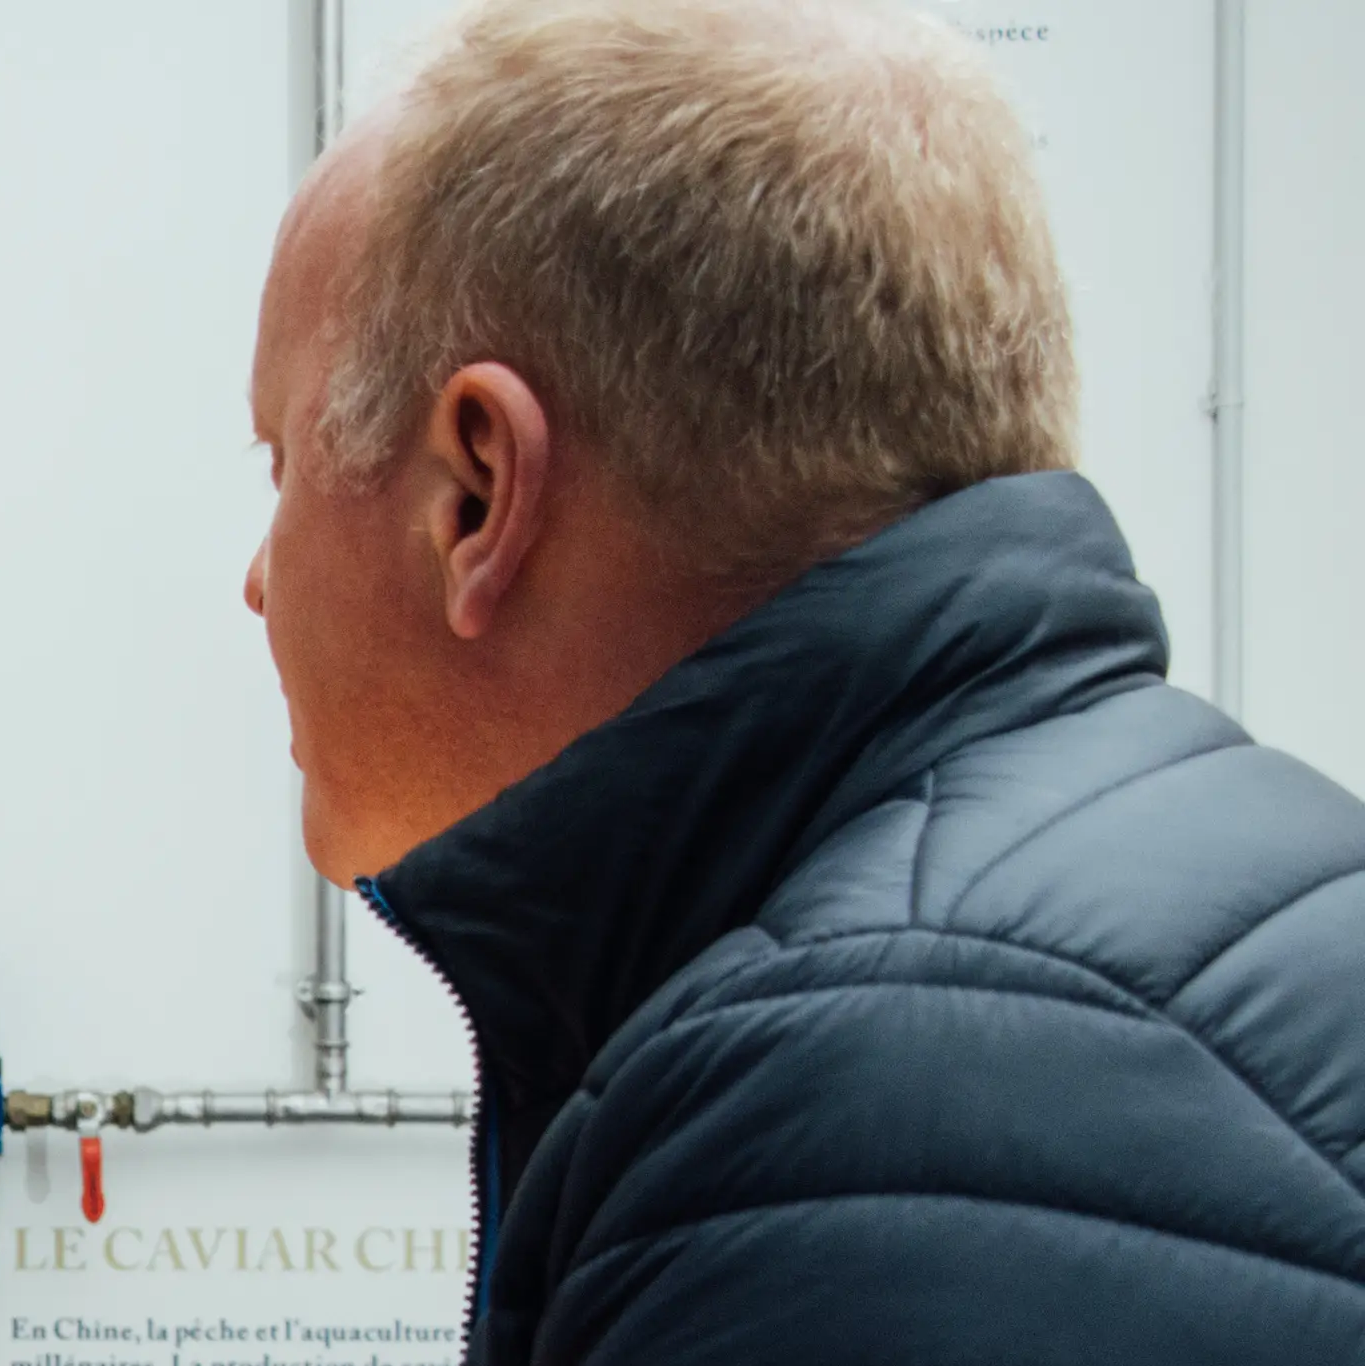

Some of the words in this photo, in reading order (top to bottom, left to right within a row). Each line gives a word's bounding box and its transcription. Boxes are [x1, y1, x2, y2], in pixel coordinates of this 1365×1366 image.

[13, 1225, 87, 1273] LE
[102, 1225, 342, 1273] CAVIAR
[11, 1318, 46, 1342] En
[54, 1317, 141, 1346] Chine,
[147, 1318, 168, 1342] la
[174, 1317, 249, 1349] pêche
[255, 1324, 277, 1342] et
[284, 1317, 456, 1349] l'aquaculture
